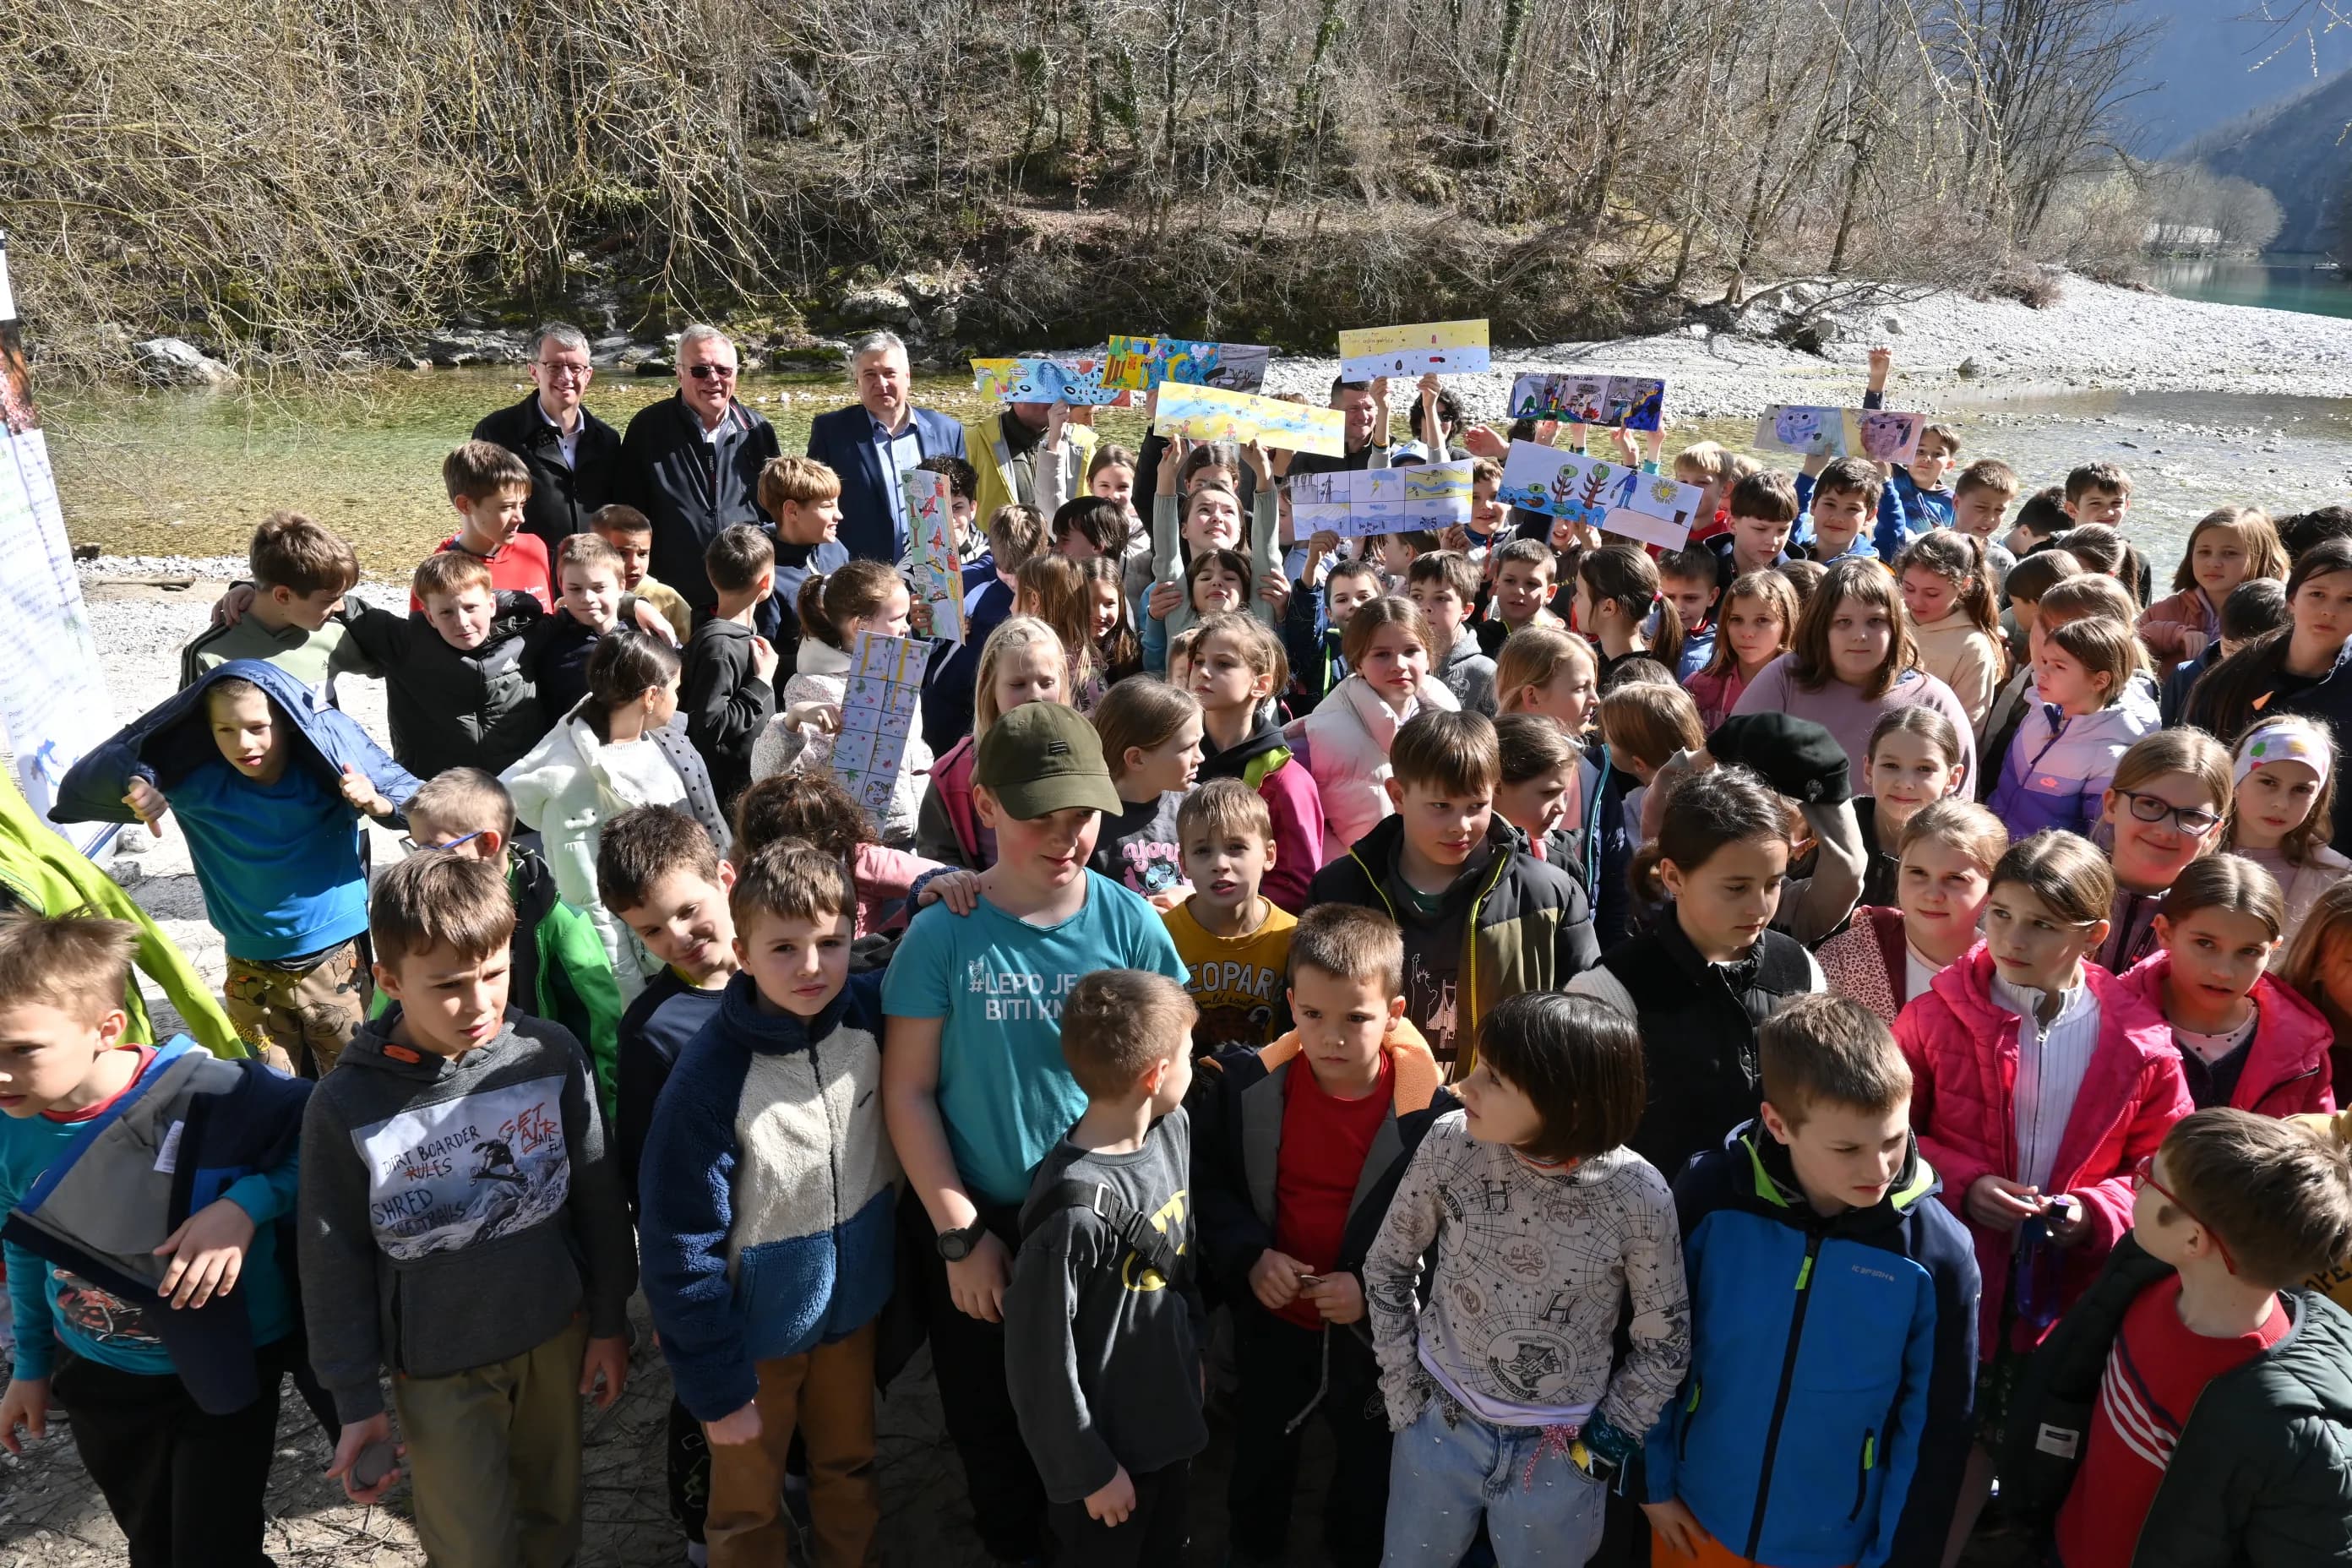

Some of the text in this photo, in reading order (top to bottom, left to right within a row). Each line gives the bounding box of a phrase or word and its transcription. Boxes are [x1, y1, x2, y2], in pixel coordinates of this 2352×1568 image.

[968, 972, 1045, 995] #LEPO
[985, 999, 1032, 1021] BITI
[498, 1102, 546, 1135] GET
[416, 1124, 481, 1162] BOARDER
[406, 1157, 453, 1182] RULES
[371, 1188, 433, 1226] SHRED
